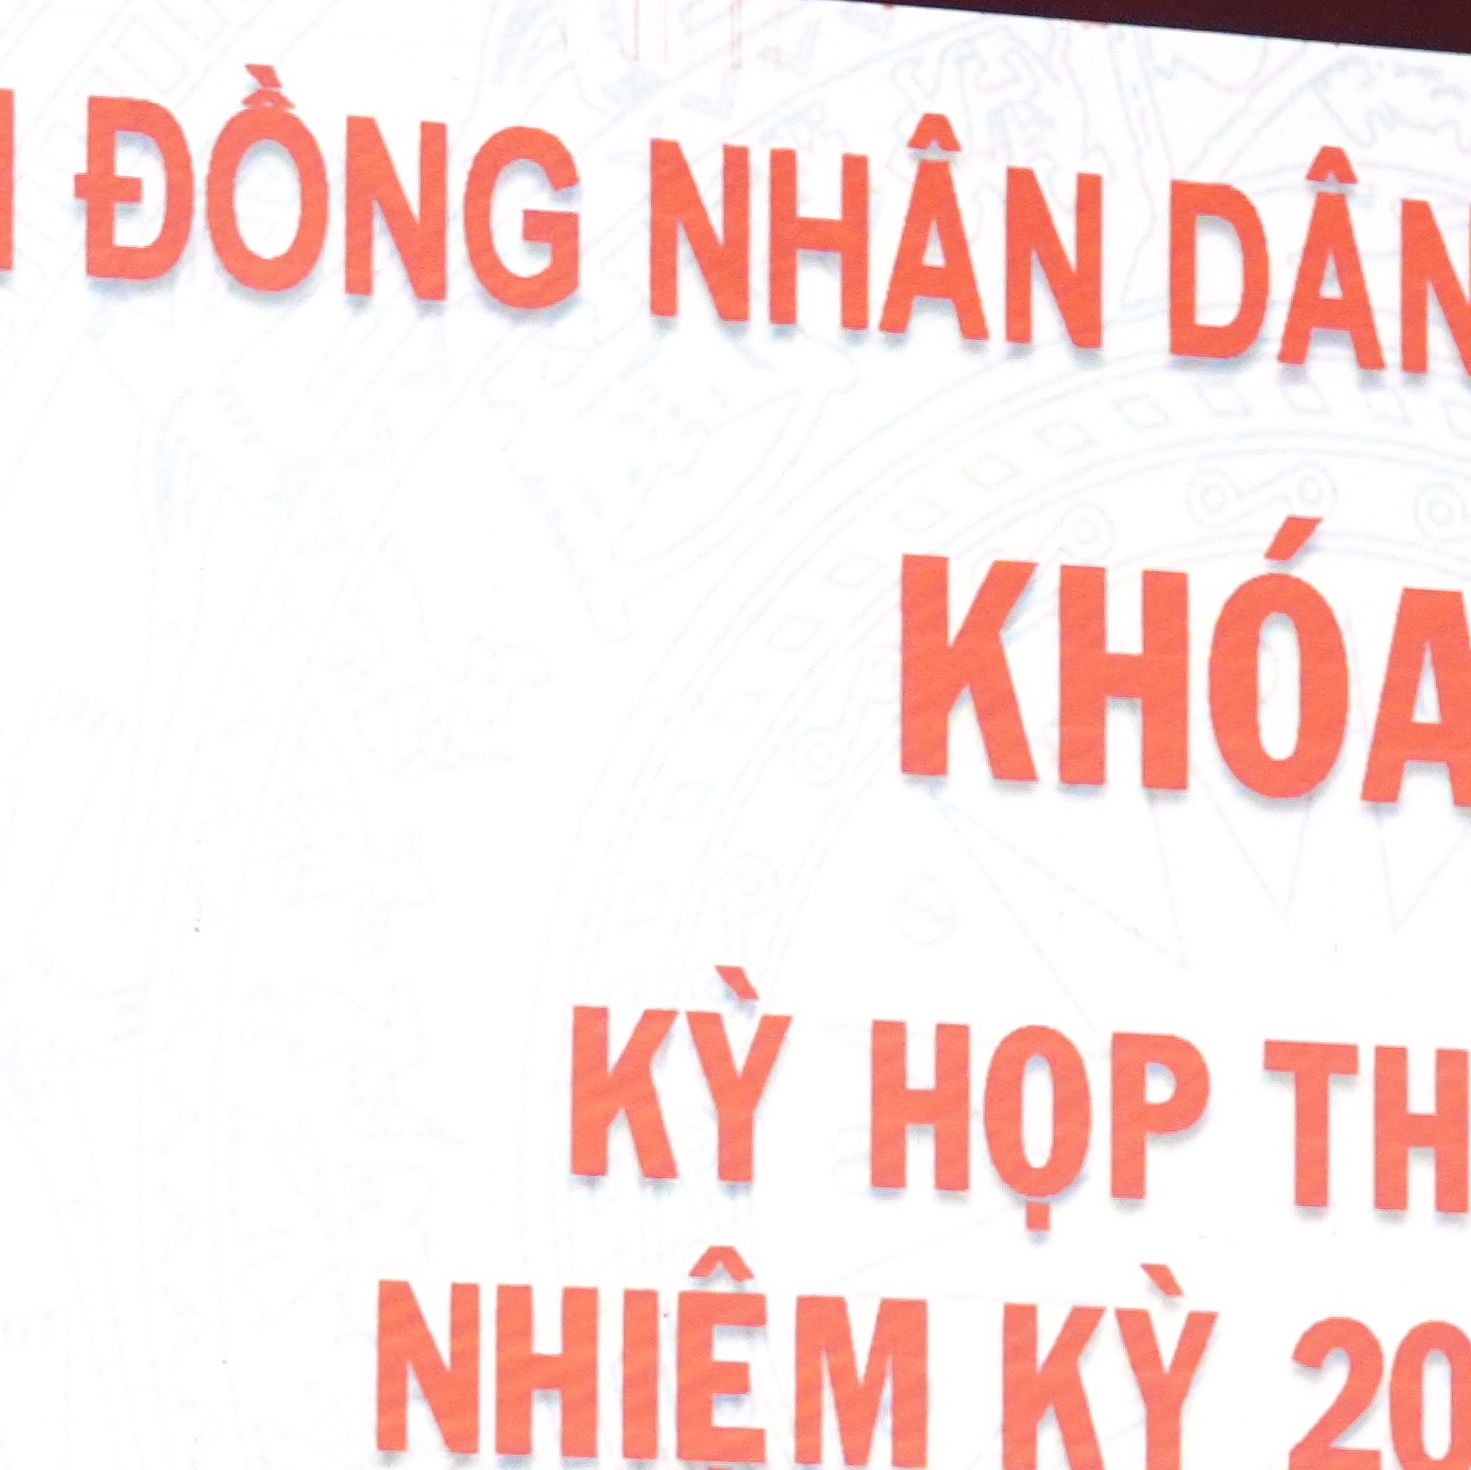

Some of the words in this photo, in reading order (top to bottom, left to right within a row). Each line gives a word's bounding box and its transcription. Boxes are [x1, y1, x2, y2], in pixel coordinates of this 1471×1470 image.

[74, 63, 580, 311] ĐỒNG
[650, 113, 1103, 349] NHÂN
[571, 965, 793, 1183] KỲ
[870, 1020, 1211, 1232] HỌP
